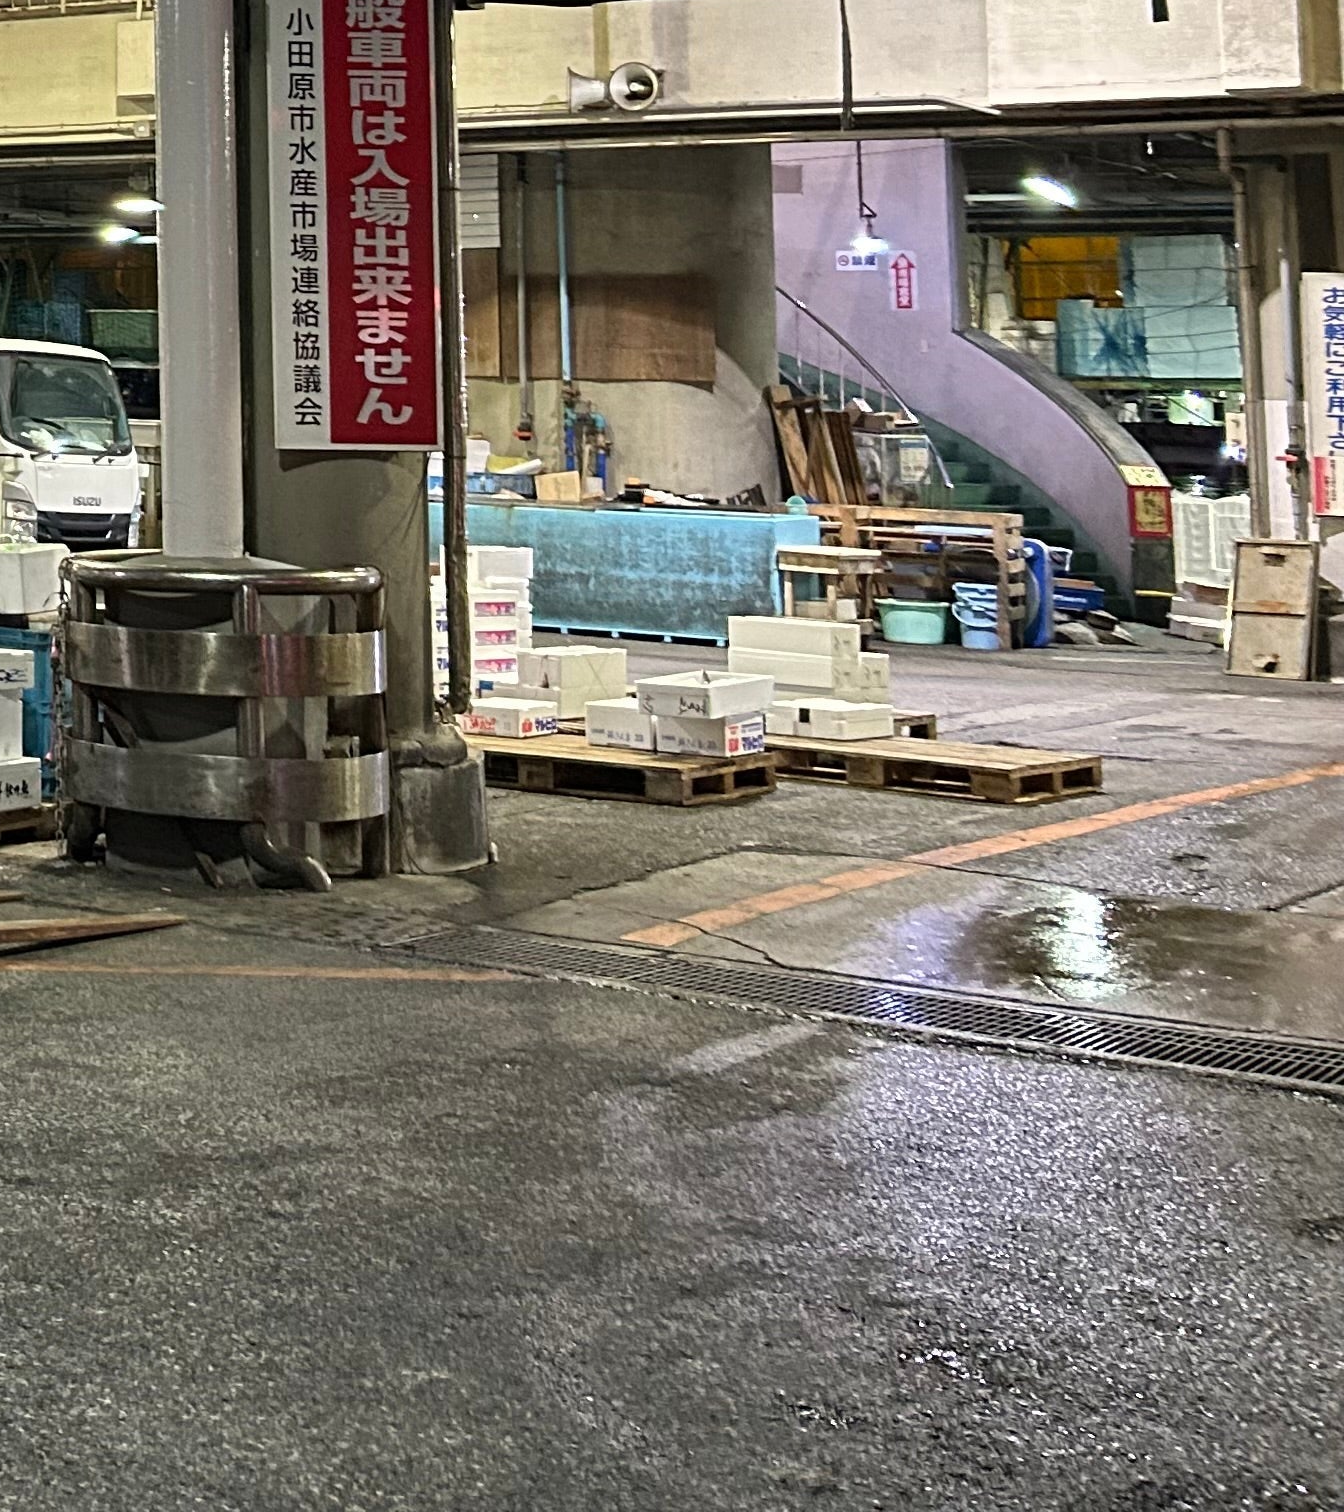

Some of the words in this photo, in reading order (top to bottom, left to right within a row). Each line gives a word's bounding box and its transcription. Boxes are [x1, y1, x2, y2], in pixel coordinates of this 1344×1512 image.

[286, 7, 323, 426] 小田原市水産市場連絡協議会
[72, 496, 101, 506] ISUZU
